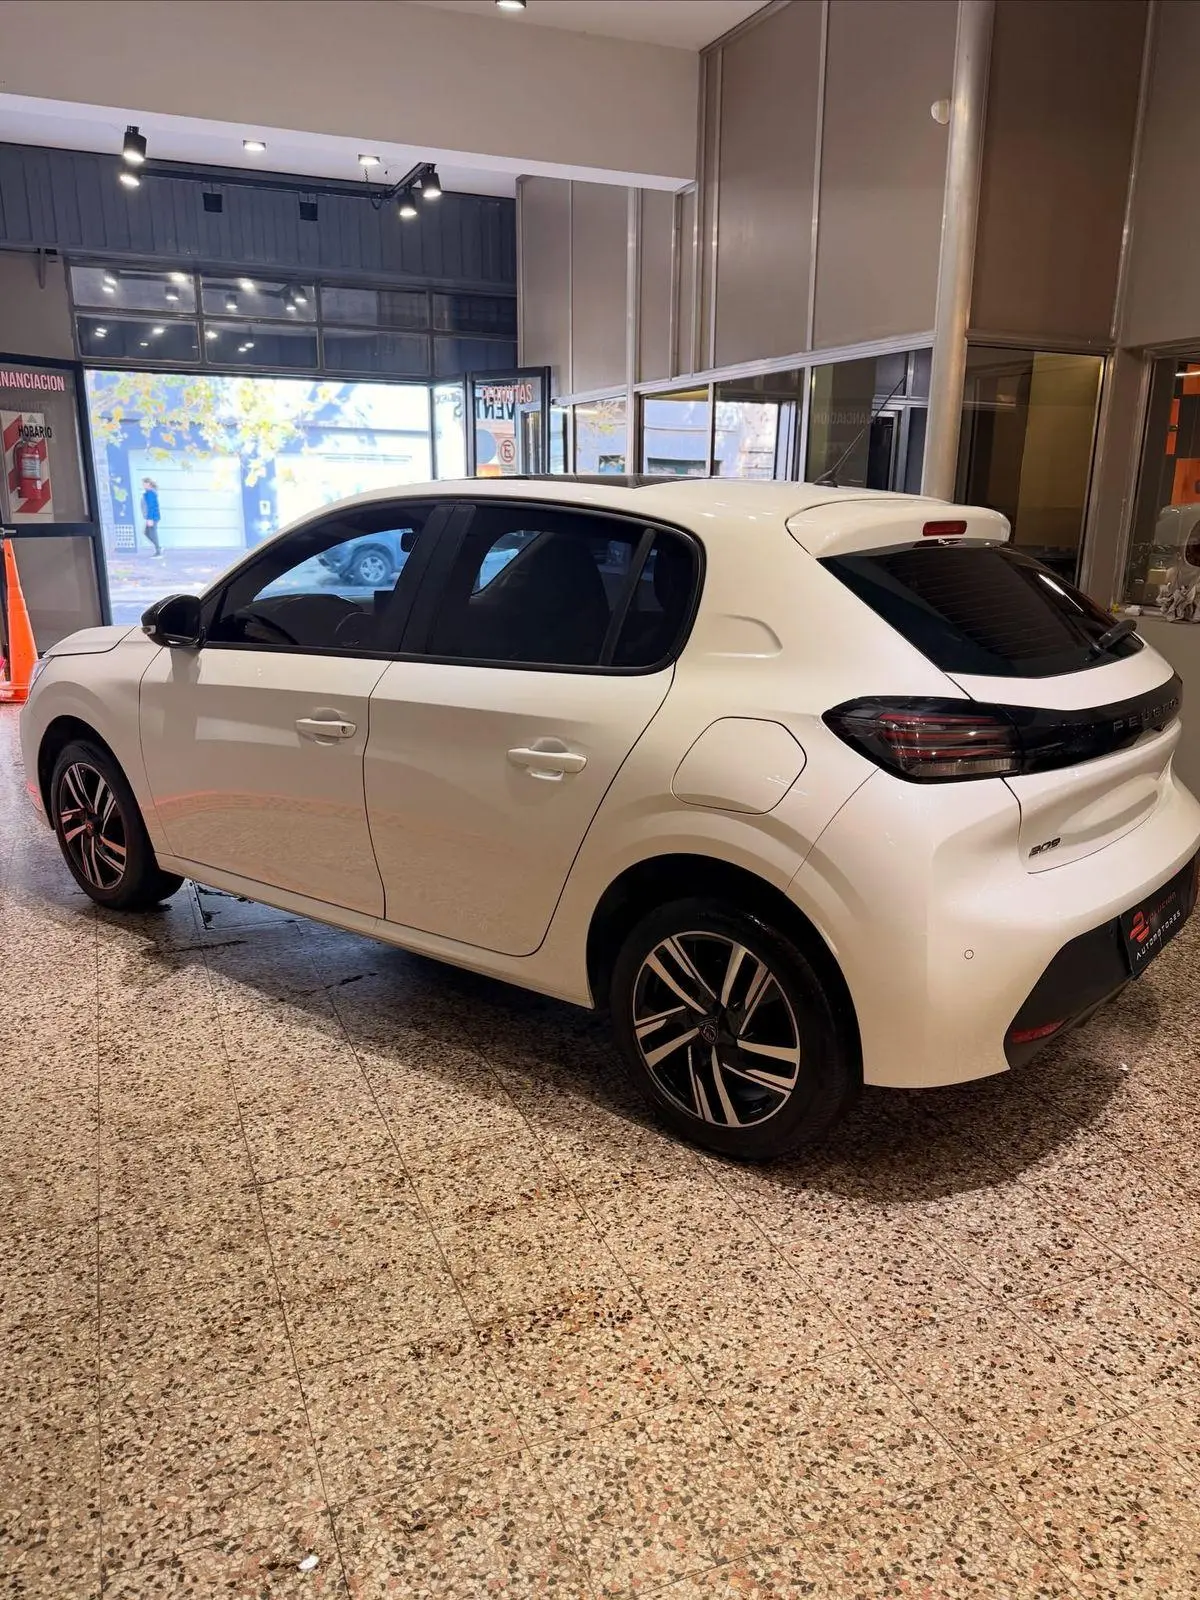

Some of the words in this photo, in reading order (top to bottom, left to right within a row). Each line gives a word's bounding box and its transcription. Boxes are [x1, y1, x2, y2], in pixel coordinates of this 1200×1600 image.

[0, 371, 65, 391] NANCIACION
[1028, 837, 1061, 858] 208
[1136, 910, 1181, 960] AUTOMOTORES
